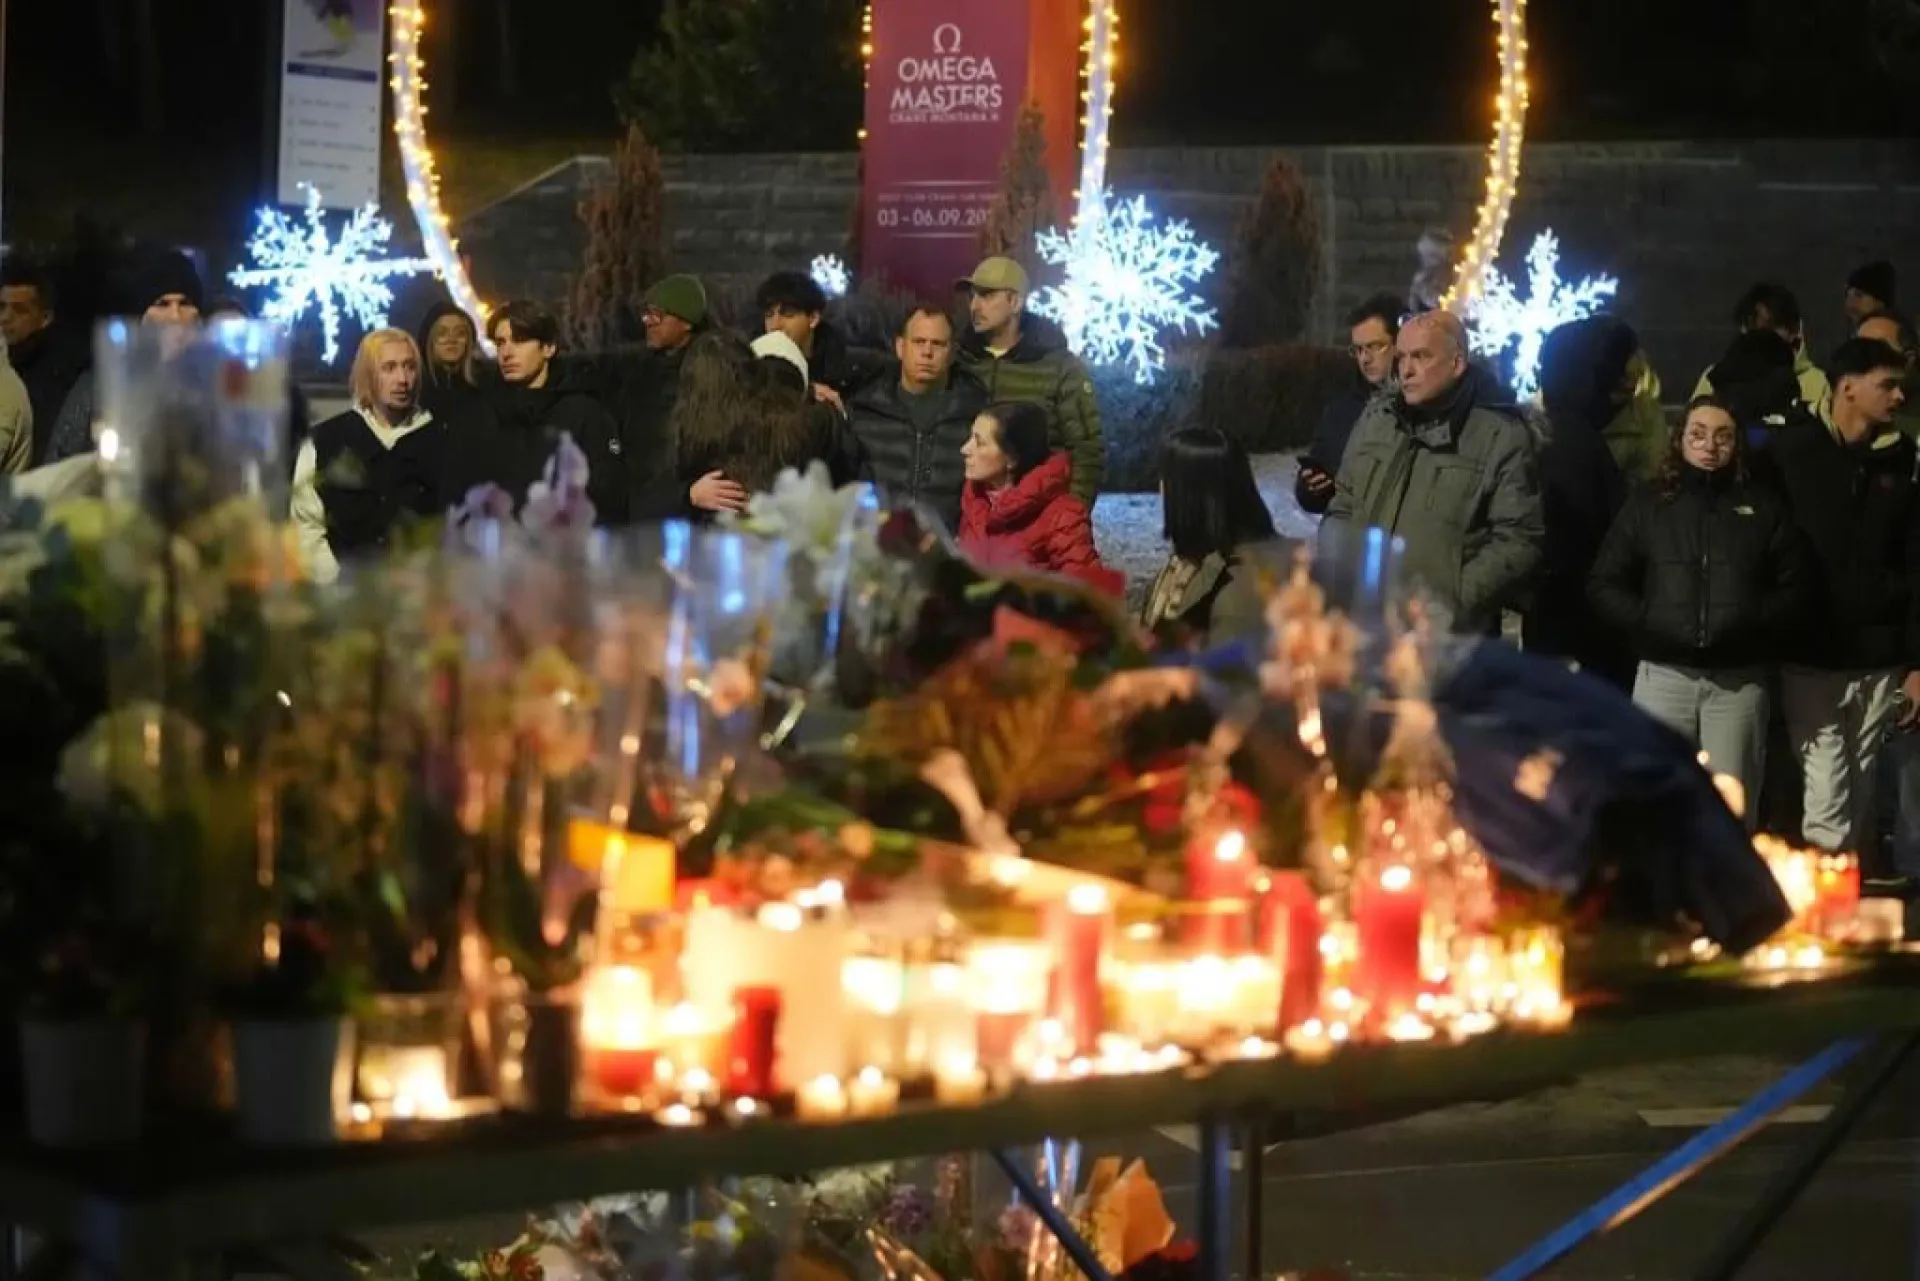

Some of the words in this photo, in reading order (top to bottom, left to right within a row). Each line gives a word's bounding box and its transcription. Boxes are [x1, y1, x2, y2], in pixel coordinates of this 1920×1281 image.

[898, 57, 997, 82] OMEGA
[891, 84, 1002, 109] MASTERS
[877, 209, 898, 225] 03
[912, 208, 991, 226] 06.09.20
